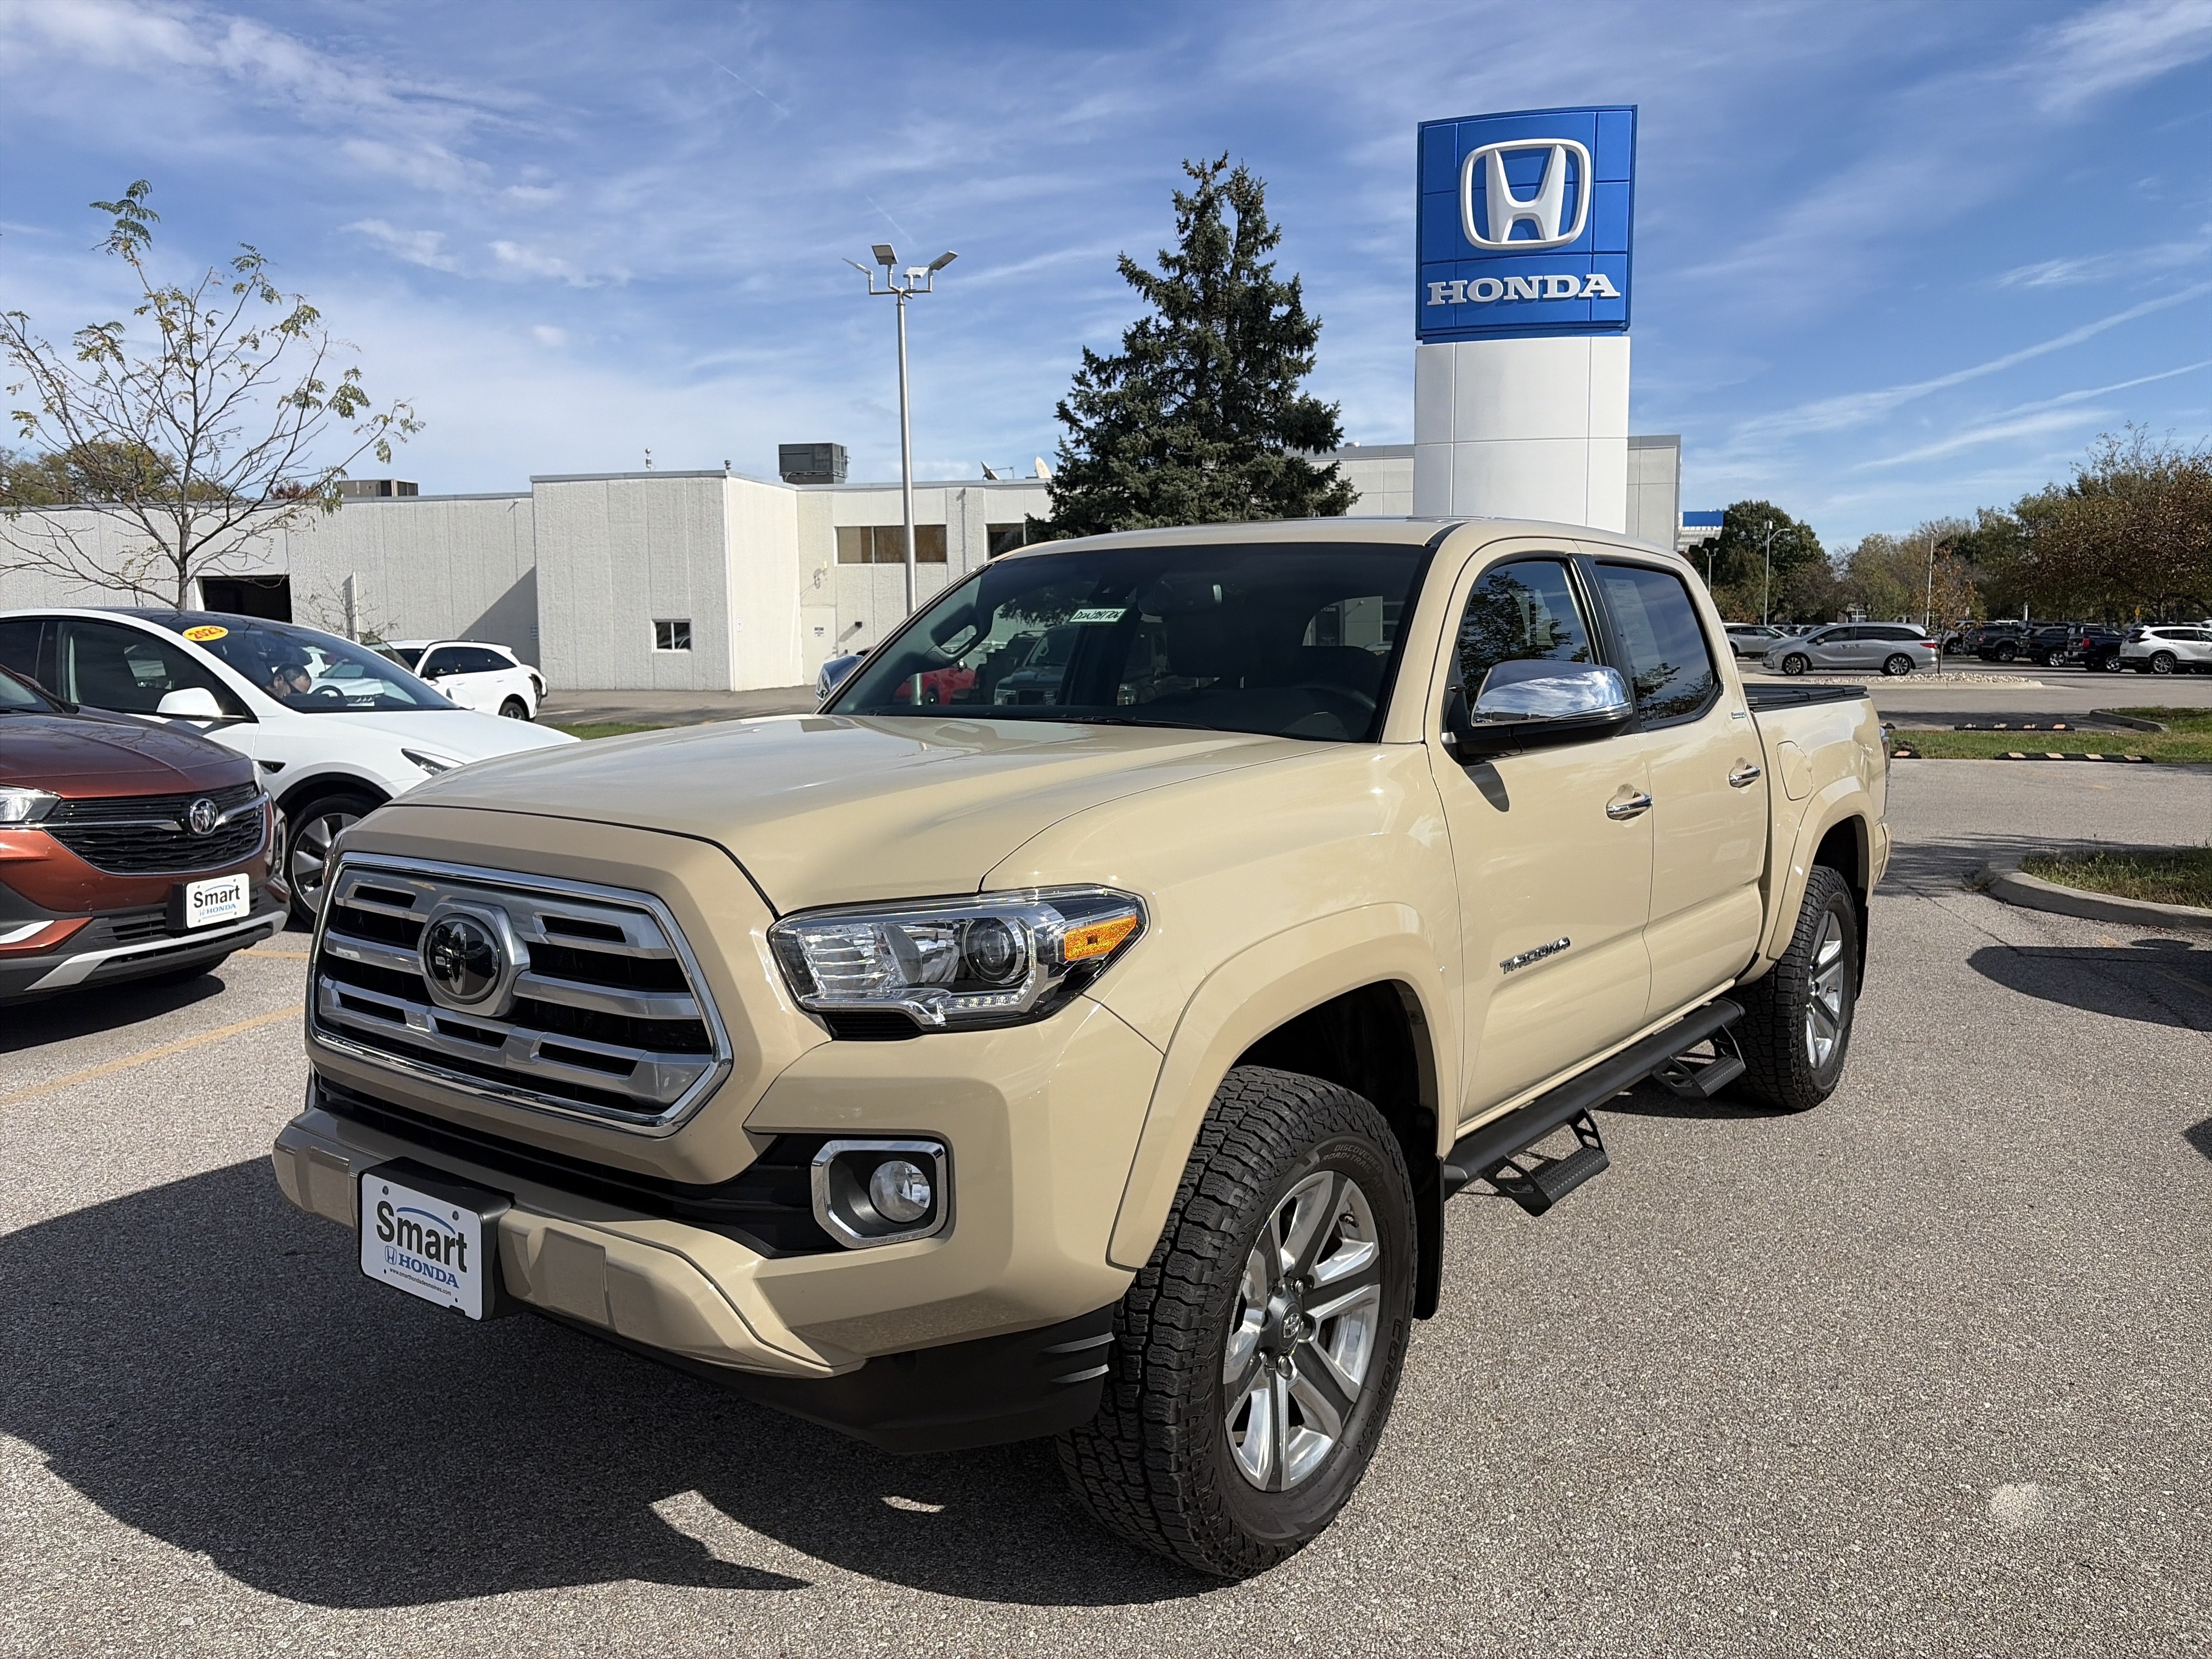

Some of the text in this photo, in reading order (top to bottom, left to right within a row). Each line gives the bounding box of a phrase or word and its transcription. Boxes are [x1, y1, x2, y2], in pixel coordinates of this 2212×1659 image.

[1427, 274, 1621, 306] HONDA
[188, 627, 224, 639] 2023
[194, 885, 240, 909] Smart
[206, 904, 236, 915] HONDA
[1499, 936, 1571, 974] TACOMA
[1334, 1144, 1383, 1173] DISCOVERER
[376, 1201, 467, 1273] Smart
[399, 1252, 460, 1289] HONDA
[1357, 1318, 1402, 1455] COOPER
